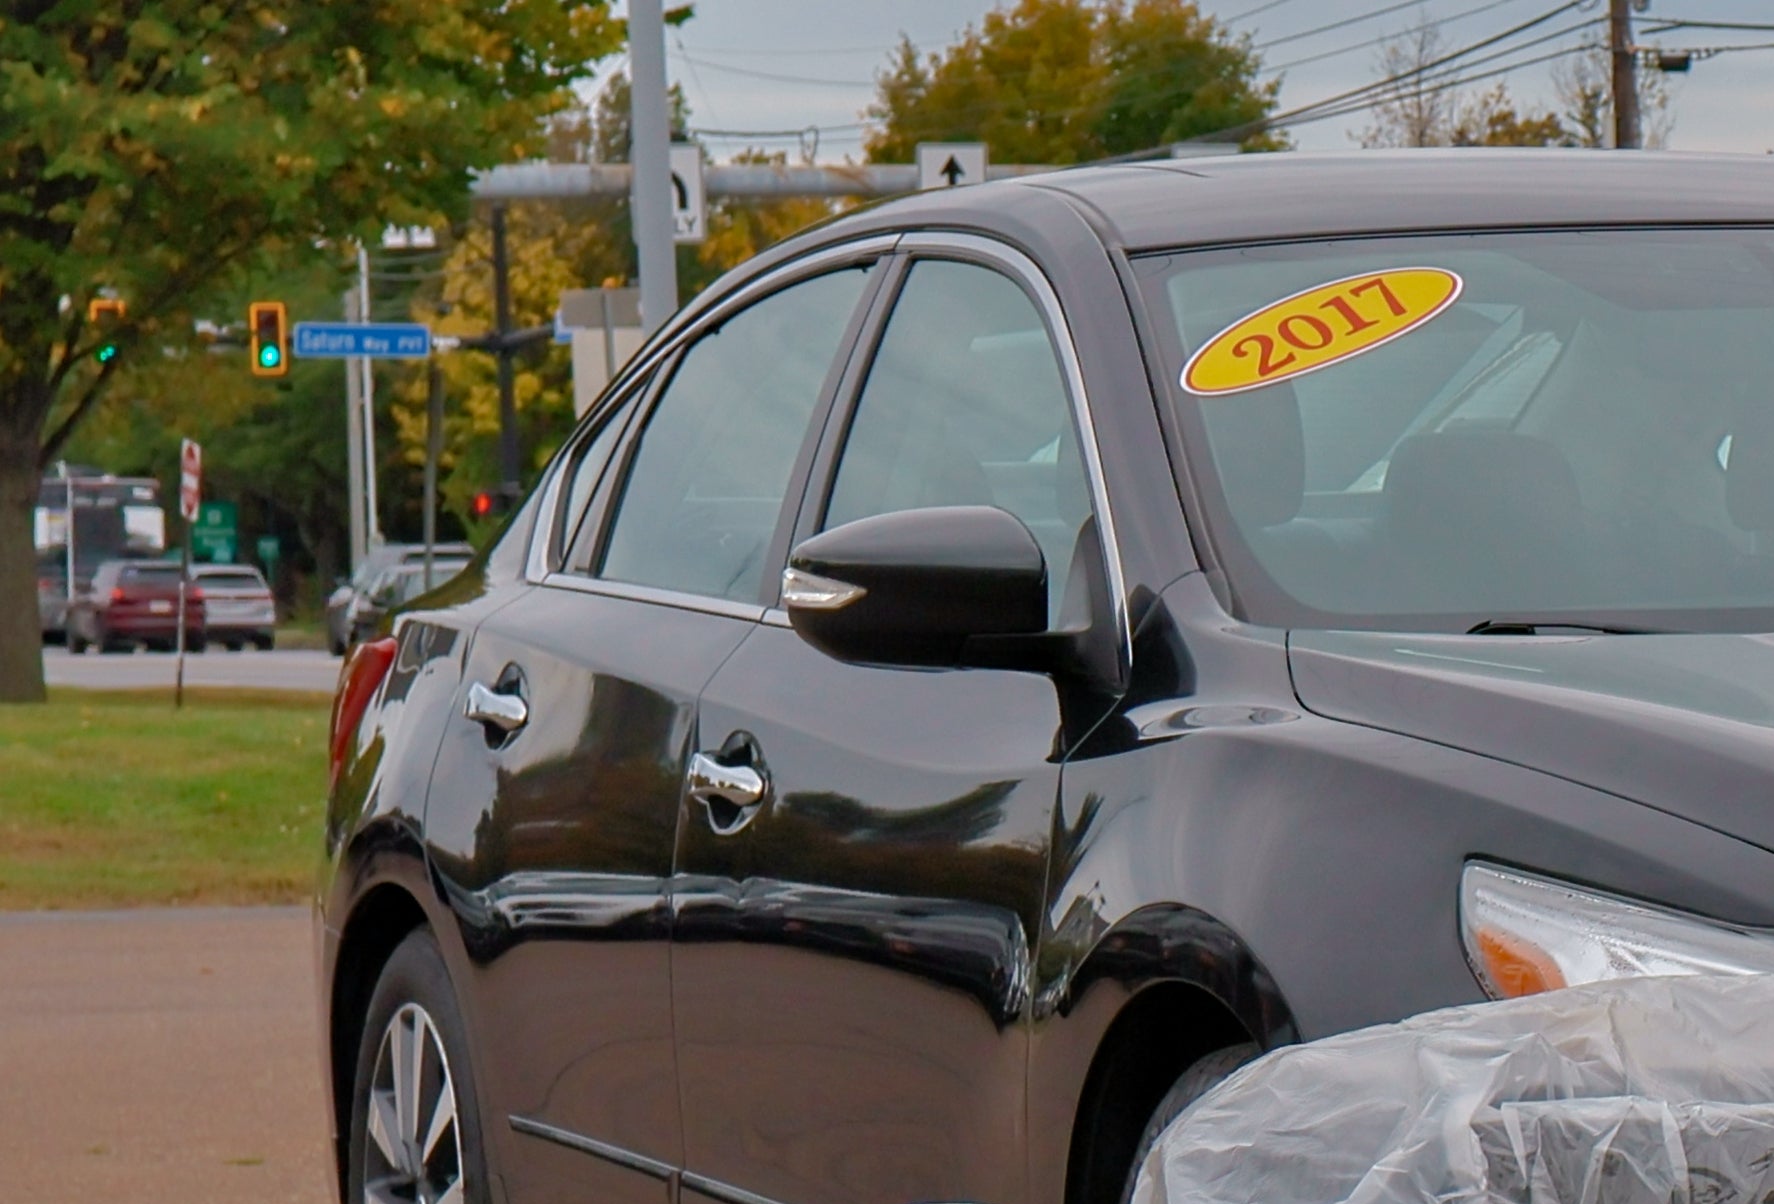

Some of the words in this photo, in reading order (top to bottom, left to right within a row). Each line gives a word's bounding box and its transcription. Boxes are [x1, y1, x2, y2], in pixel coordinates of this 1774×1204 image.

[301, 330, 355, 351] Saturn
[363, 336, 389, 353] Way
[1232, 278, 1408, 377] 2017
